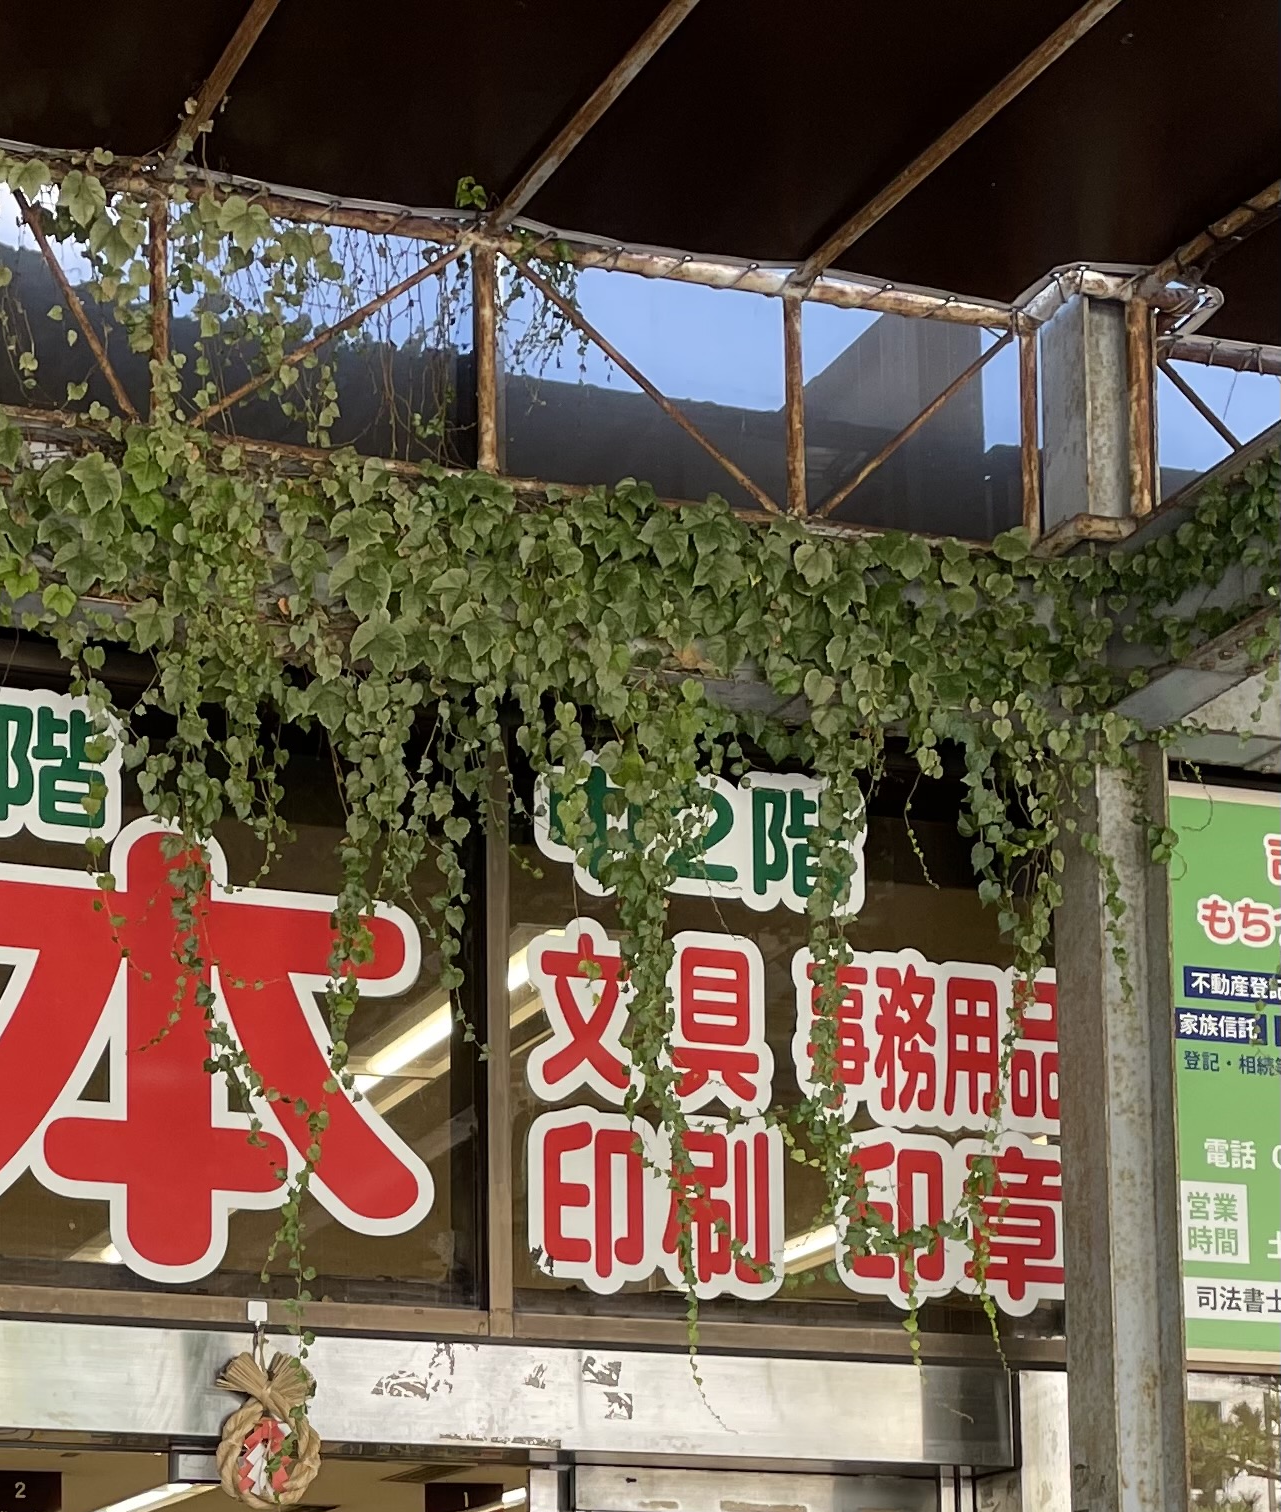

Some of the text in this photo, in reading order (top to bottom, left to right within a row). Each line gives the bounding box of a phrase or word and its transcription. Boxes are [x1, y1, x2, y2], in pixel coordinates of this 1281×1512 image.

[540, 933, 1061, 1121] 文具 事務用品
[1179, 1012, 1259, 1040] 家族信託
[1184, 1050, 1281, 1077] 登記・相続
[1204, 1138, 1256, 1170] 電話
[543, 1121, 1065, 1301] 印刷 印章
[1187, 1191, 1239, 1222] 営業
[1187, 1225, 1239, 1256] 時間
[14, 1481, 27, 1499] 2
